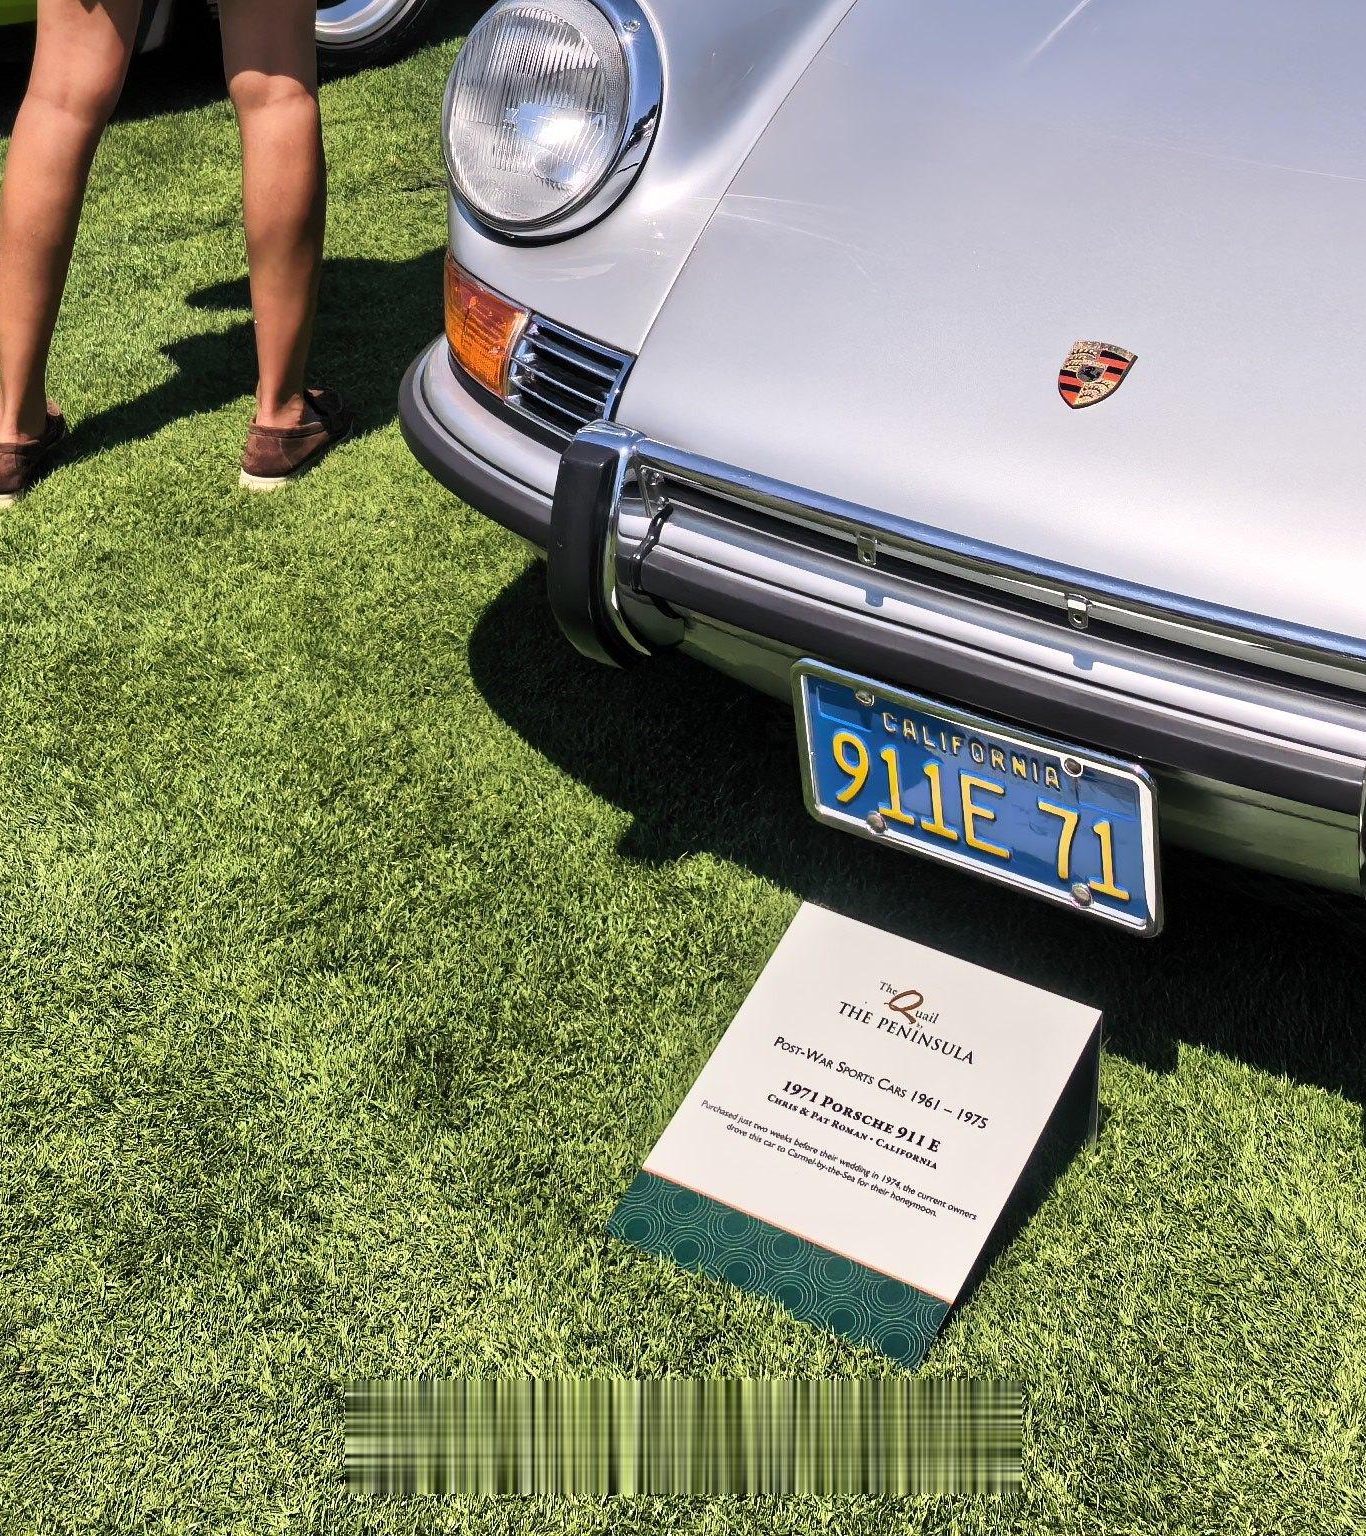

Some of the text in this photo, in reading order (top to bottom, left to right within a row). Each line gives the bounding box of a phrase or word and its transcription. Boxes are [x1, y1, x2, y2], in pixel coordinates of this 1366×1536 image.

[881, 711, 1061, 790] CALIFORNIA
[831, 729, 1131, 902] 911E 71
[837, 1001, 974, 1064] THE PENINSULA
[880, 981, 939, 1024] The Quail
[782, 1080, 942, 1152] 1971 PORSCHE 911 E
[799, 1106, 810, 1116] &
[910, 1090, 941, 1111] 1961
[956, 1108, 989, 1130] 1975
[701, 1099, 739, 1121] Purchased
[737, 1115, 753, 1127] just
[753, 1123, 768, 1133] two
[770, 1129, 793, 1144] weeks
[794, 1137, 818, 1154] before
[819, 1150, 838, 1162] their
[839, 1159, 871, 1178] wedding
[871, 1171, 879, 1180] in
[902, 1184, 915, 1195] the
[917, 1191, 947, 1208] current
[947, 1204, 977, 1221] owners
[726, 1123, 748, 1137] drove
[748, 1133, 762, 1144] this
[763, 1140, 776, 1148] car
[776, 1145, 786, 1153] to
[856, 1177, 870, 1188] for
[870, 1184, 890, 1196] their
